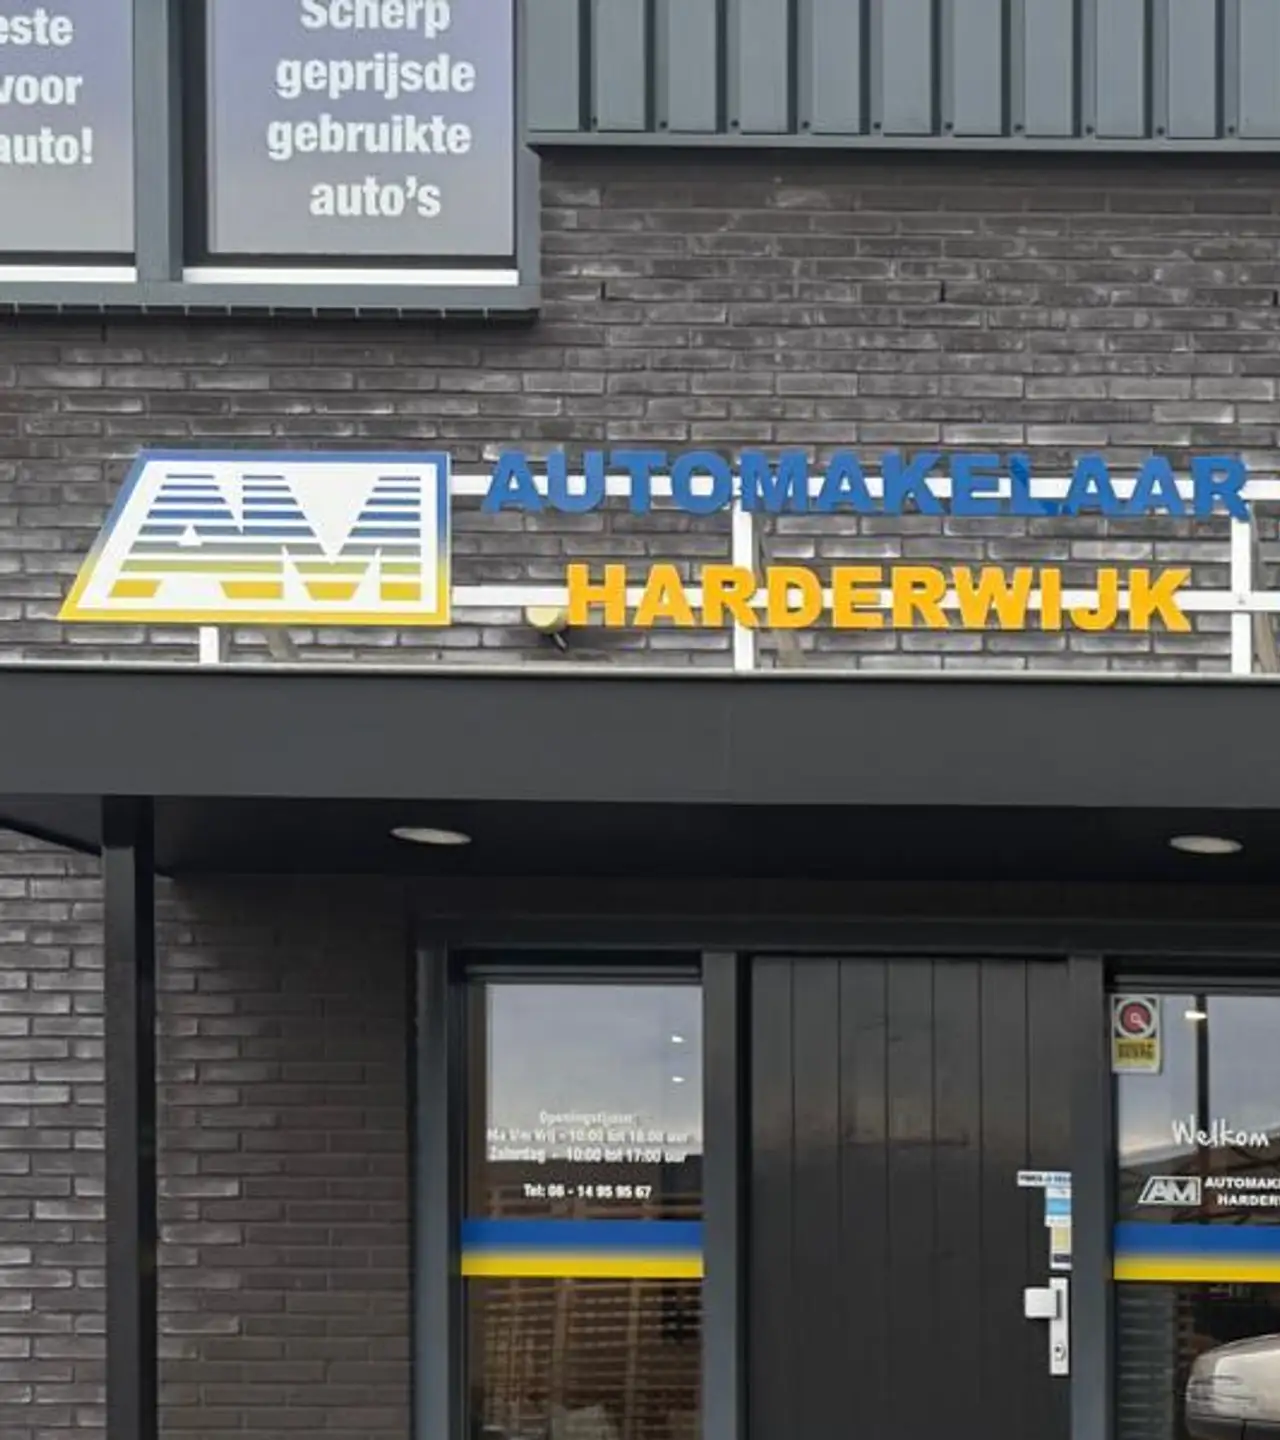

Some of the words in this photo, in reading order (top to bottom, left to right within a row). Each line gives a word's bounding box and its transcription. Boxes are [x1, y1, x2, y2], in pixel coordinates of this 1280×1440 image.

[276, 52, 476, 99] geprijsde
[267, 113, 472, 160] gebruikte
[310, 175, 441, 218] auto's
[481, 450, 1250, 521] AUTOMAKELAAR
[110, 474, 422, 601] AM
[566, 563, 1192, 632] HARDERWIJK
[1172, 1114, 1270, 1147] Welkom
